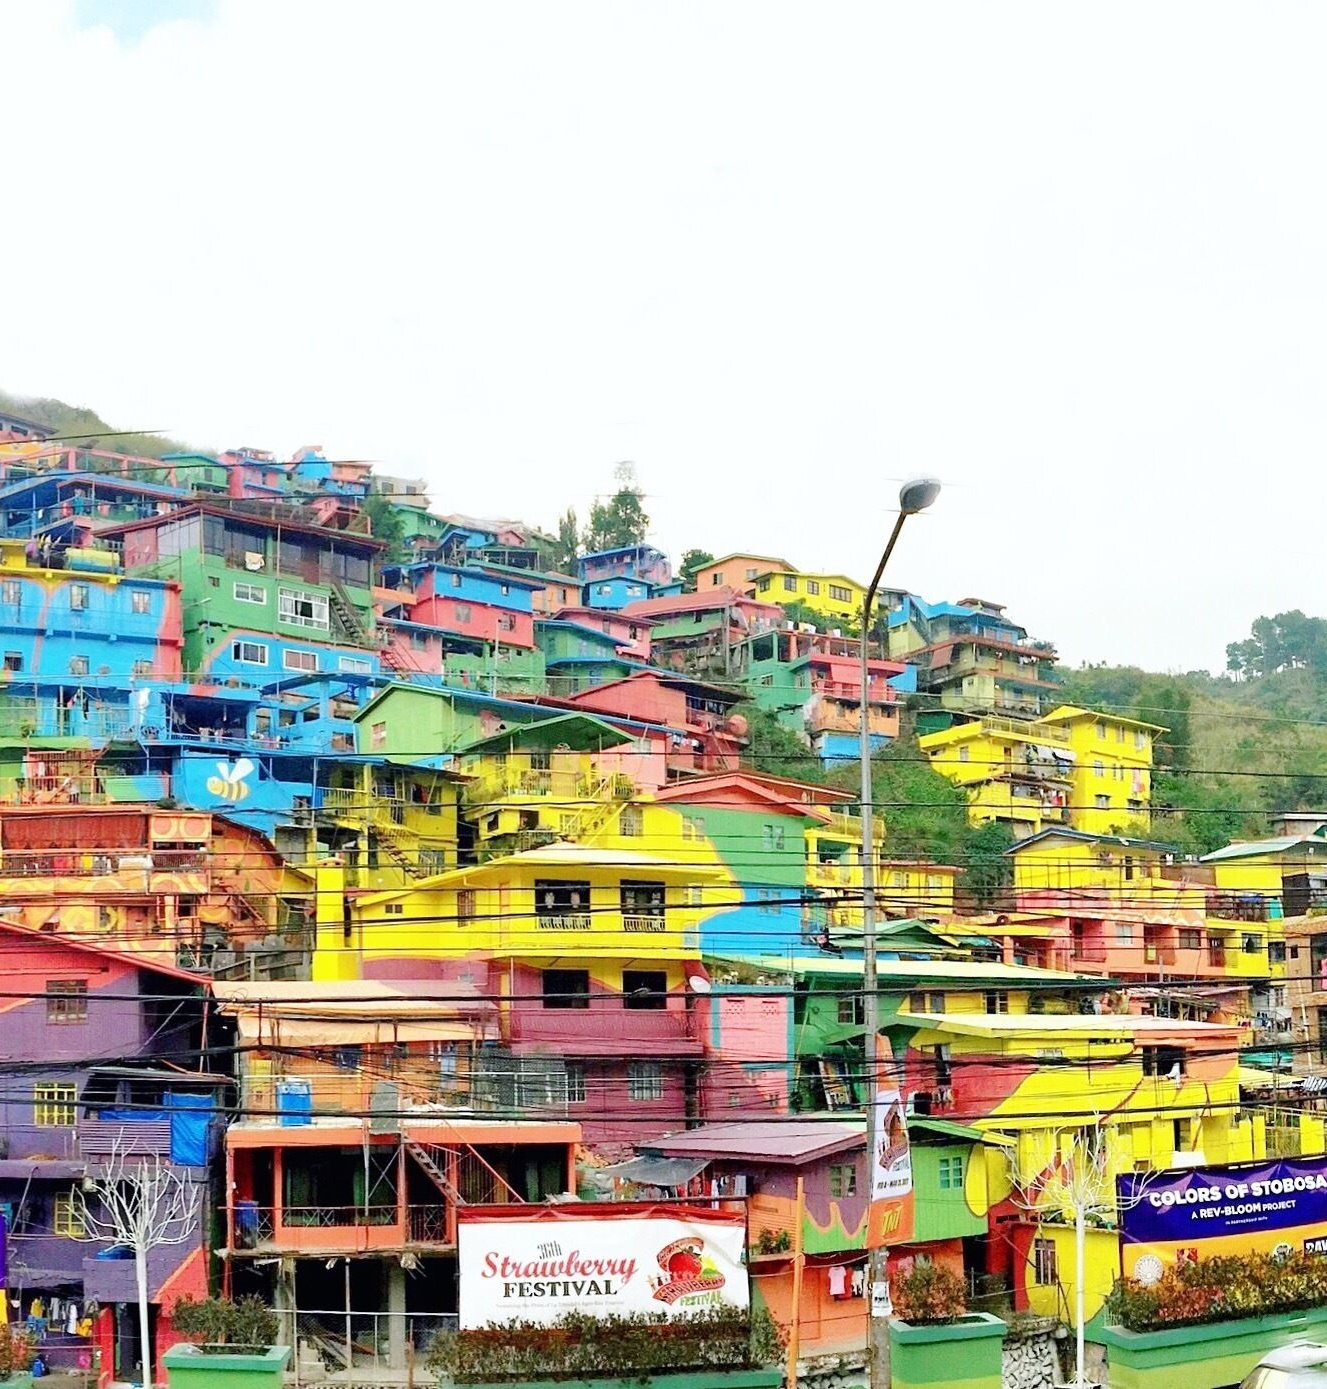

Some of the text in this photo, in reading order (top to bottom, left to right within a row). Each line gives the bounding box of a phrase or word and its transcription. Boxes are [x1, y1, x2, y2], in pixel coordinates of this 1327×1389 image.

[1149, 1174, 1327, 1207] COLORS OF STOBOSA
[1191, 1200, 1297, 1220] A REV-BLOOM PROJECT
[481, 1250, 639, 1286] Strawberry
[502, 1279, 618, 1298] FESTIVAL
